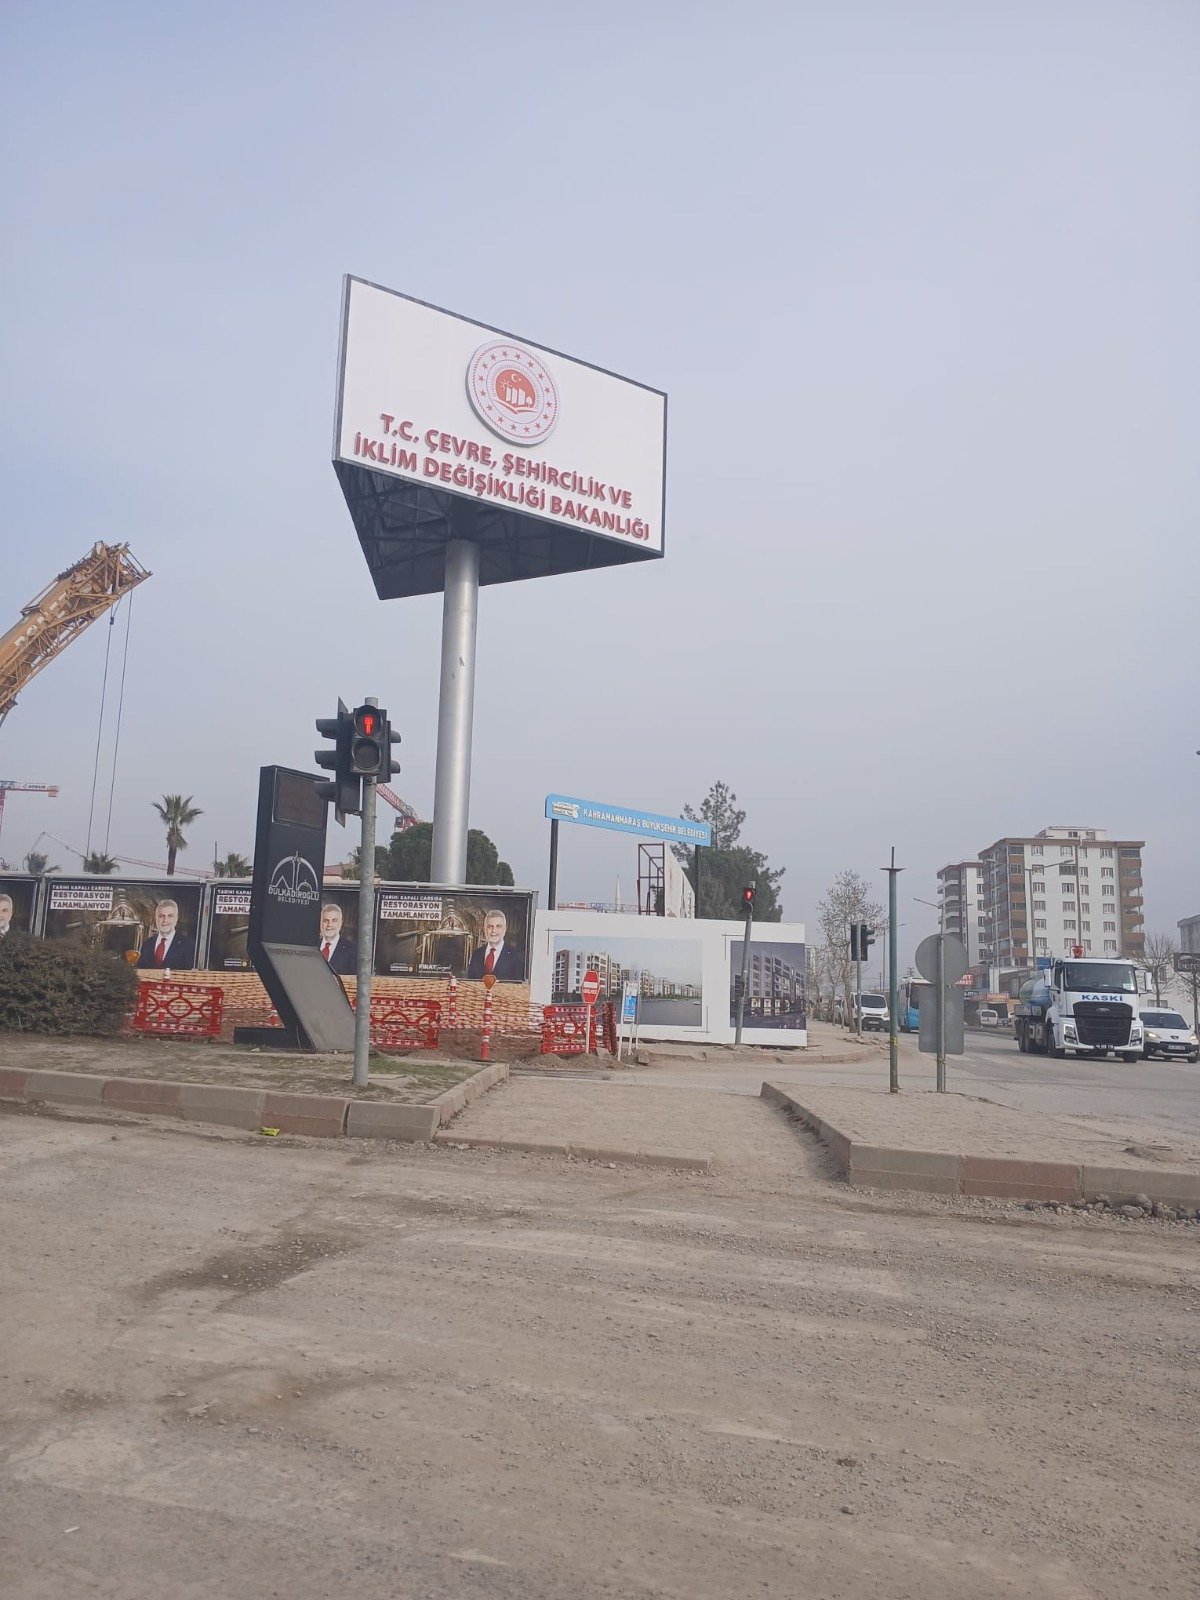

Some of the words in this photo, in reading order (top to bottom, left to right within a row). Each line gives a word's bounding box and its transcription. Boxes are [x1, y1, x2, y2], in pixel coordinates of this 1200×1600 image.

[353, 431, 418, 472] İKLİM
[422, 456, 546, 510] DEĞİŞİKLİĞİ
[550, 495, 650, 541] BAKANLIĞI
[379, 413, 420, 443] T.C.
[424, 429, 498, 469] ÇEVRE,
[502, 452, 607, 500] ŞEHİRCİLİK
[609, 487, 633, 509] VE
[583, 808, 641, 828] KAHRAMANMARAŞ
[642, 819, 677, 834] BÜYÜKŞEHİR
[677, 825, 708, 839] BELEDİYESİ
[1081, 993, 1123, 1002] KASKİ
